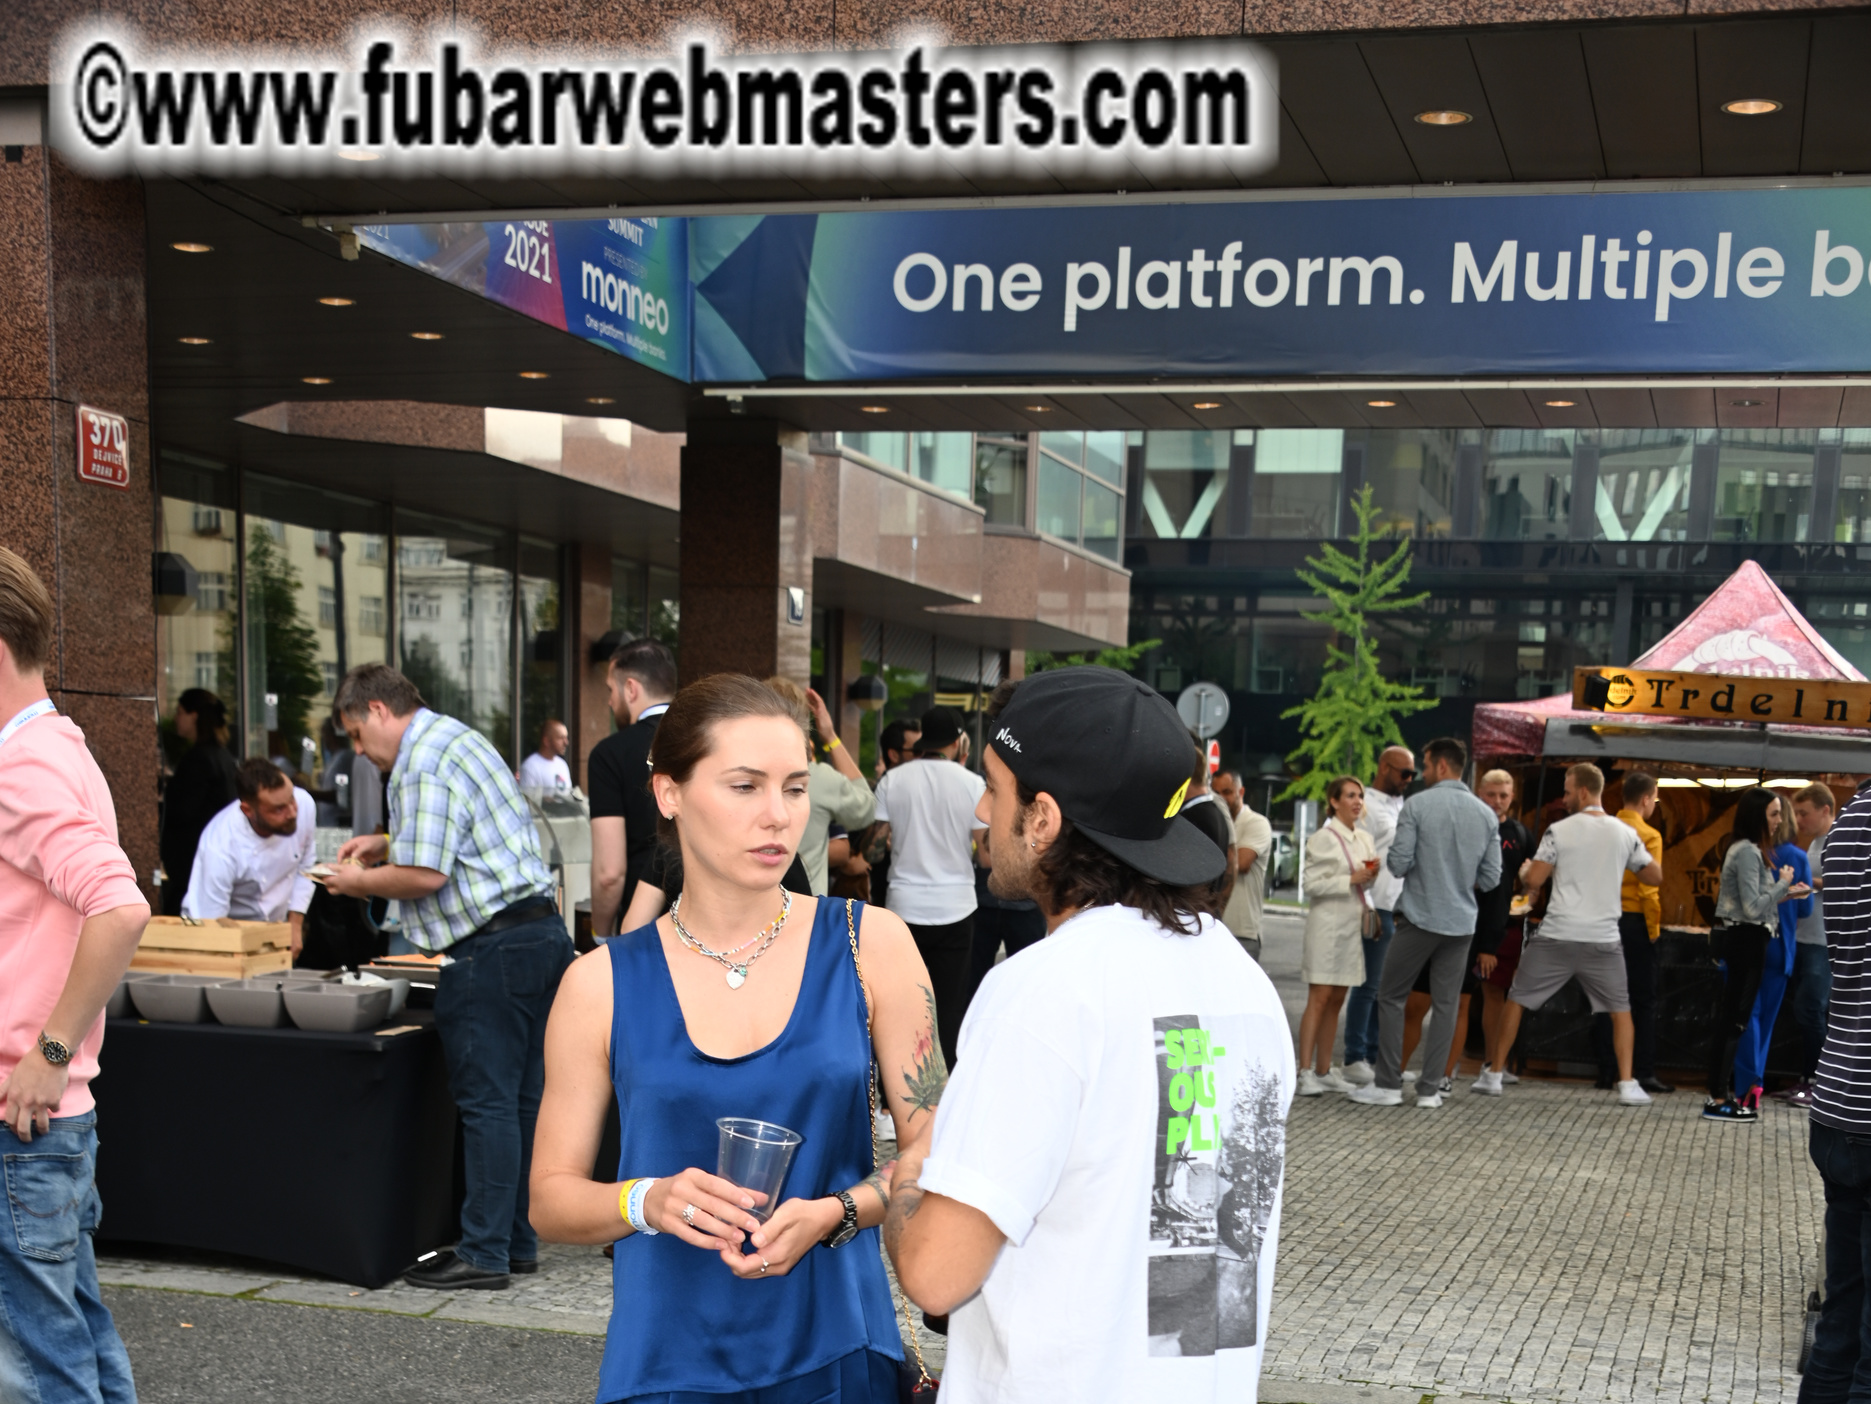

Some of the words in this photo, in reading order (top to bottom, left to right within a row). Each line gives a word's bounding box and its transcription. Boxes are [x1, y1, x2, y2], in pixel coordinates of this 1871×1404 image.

[504, 223, 552, 284] 2021
[581, 260, 670, 336] monneo
[893, 252, 1042, 312] One
[1064, 241, 1425, 332] platform.
[1451, 230, 1785, 322] Multiple
[1810, 230, 1871, 297] b
[88, 413, 123, 452] 370
[91, 463, 113, 478] PRAHA
[1646, 678, 1871, 724] Trdeln
